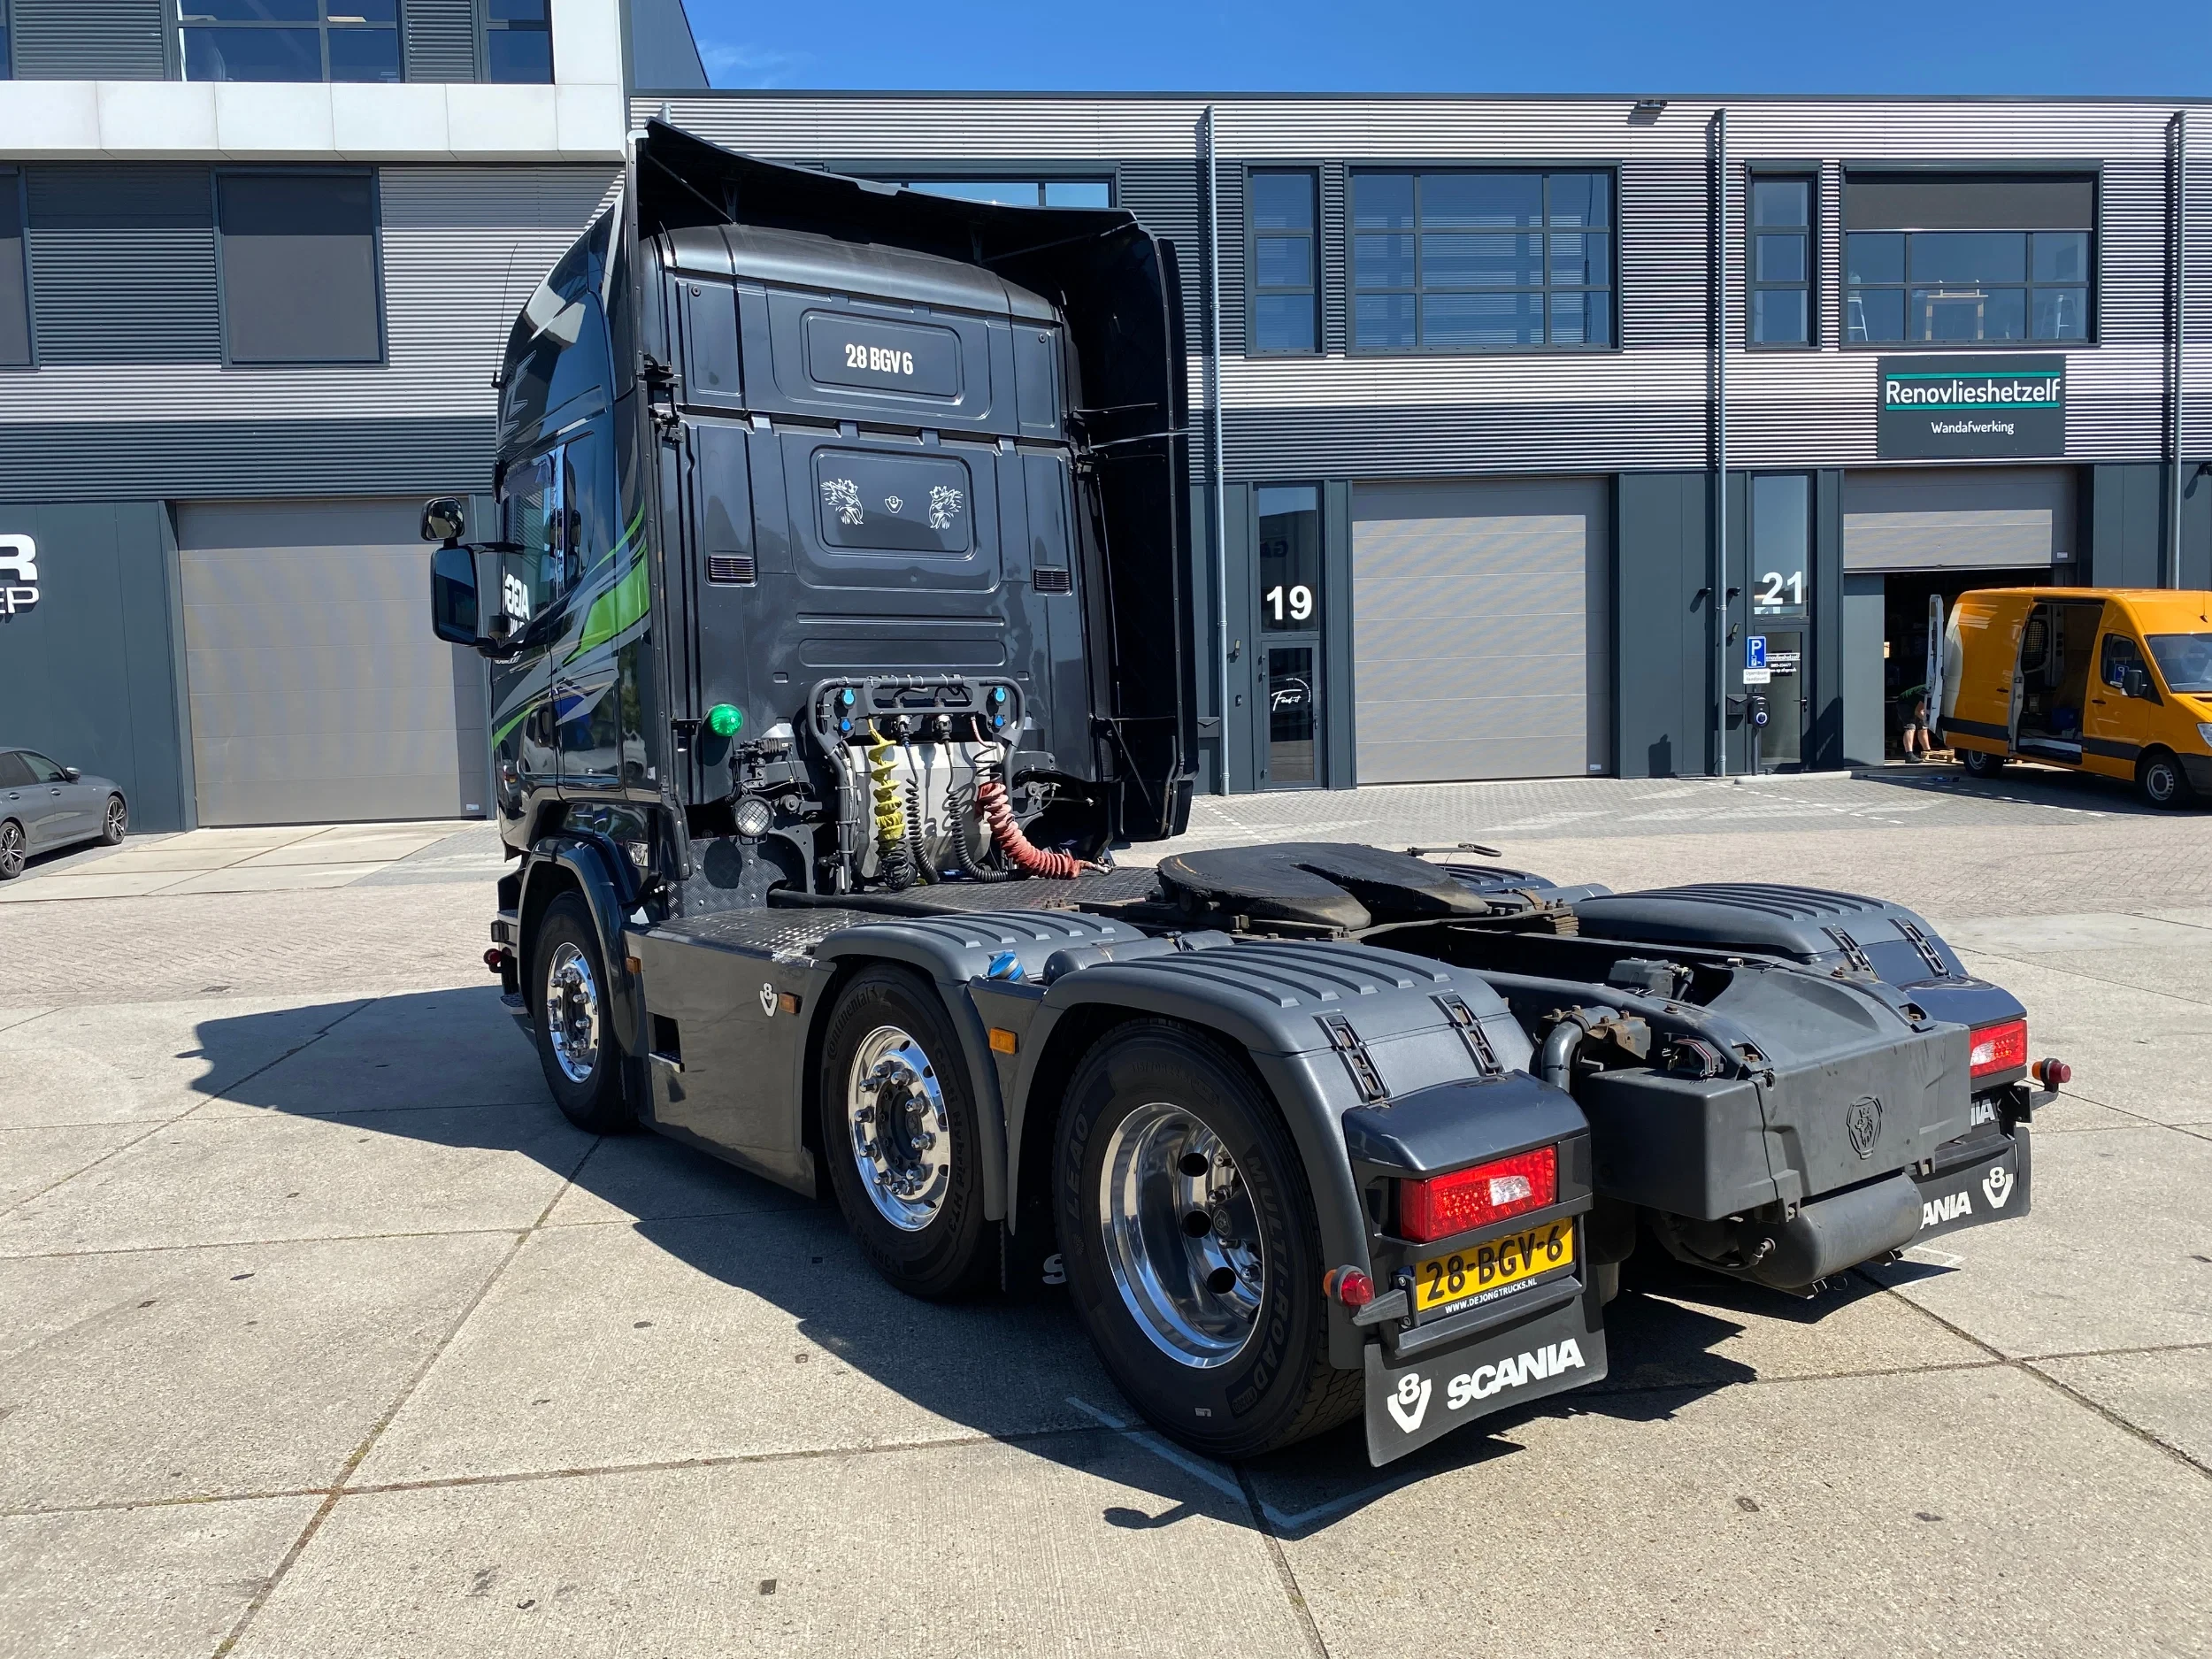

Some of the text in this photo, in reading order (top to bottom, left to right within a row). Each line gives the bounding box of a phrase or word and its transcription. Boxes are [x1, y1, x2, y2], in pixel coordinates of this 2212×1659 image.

[845, 343, 914, 375] 28 BGV 6
[1886, 378, 2061, 404] Renovlieshetzelf
[1931, 420, 2015, 434] Wandafwerking
[1266, 585, 1312, 620] 19
[1762, 571, 1801, 605] 21
[1751, 640, 1762, 656] P
[1425, 1225, 1563, 1302] 28-BGV-6
[1445, 1277, 1538, 1314] WWW.DEJONGTRUCKS.NL
[1447, 1338, 1586, 1410] SCANIA
